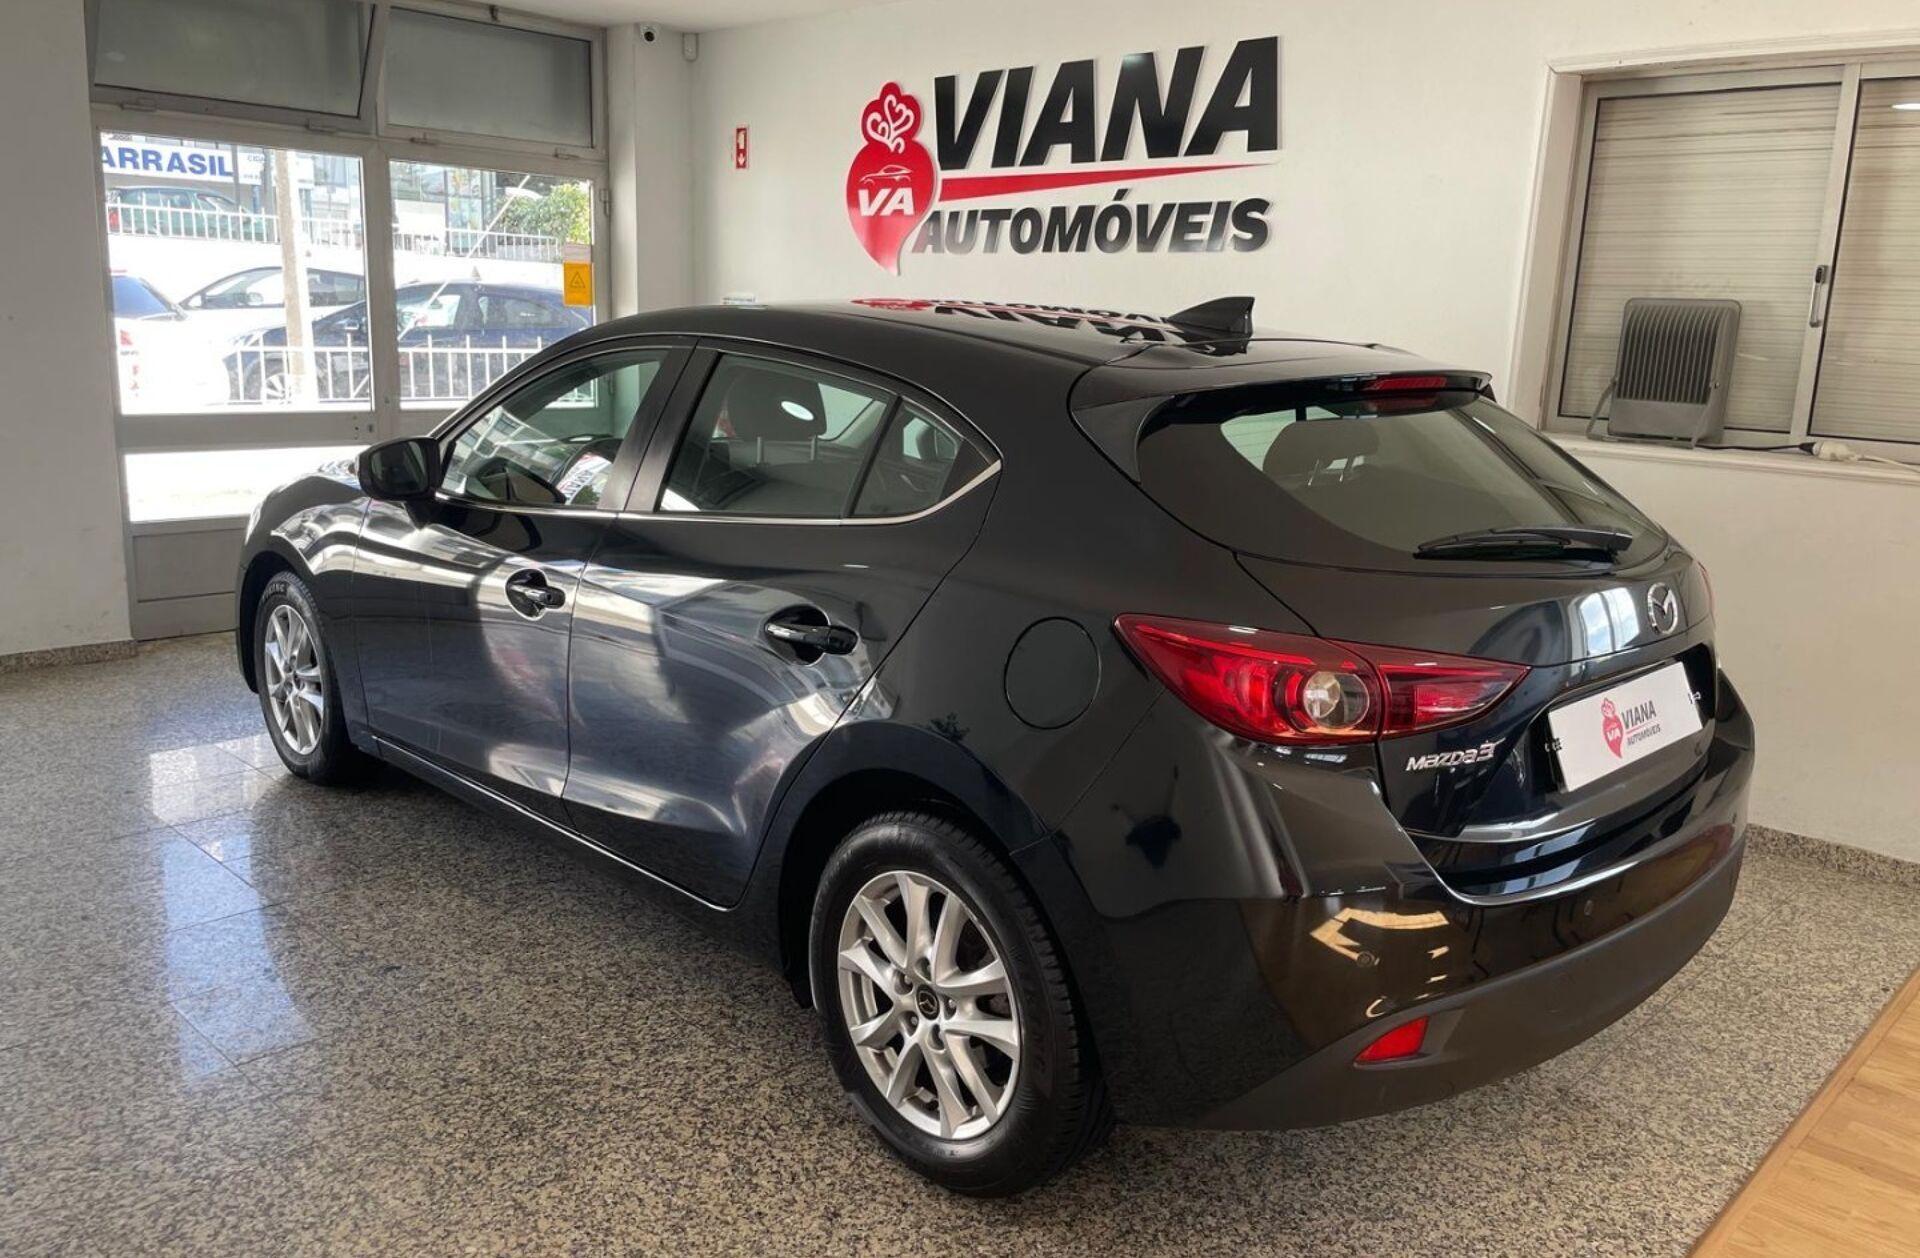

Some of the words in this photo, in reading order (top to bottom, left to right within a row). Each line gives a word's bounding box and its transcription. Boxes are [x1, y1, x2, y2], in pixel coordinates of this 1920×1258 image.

[934, 35, 1281, 171] VIANA
[101, 146, 234, 178] ARRASIL
[858, 186, 916, 217] VA
[911, 188, 1272, 256] AUTOMÓVEIS
[1620, 700, 1657, 730] VIANA
